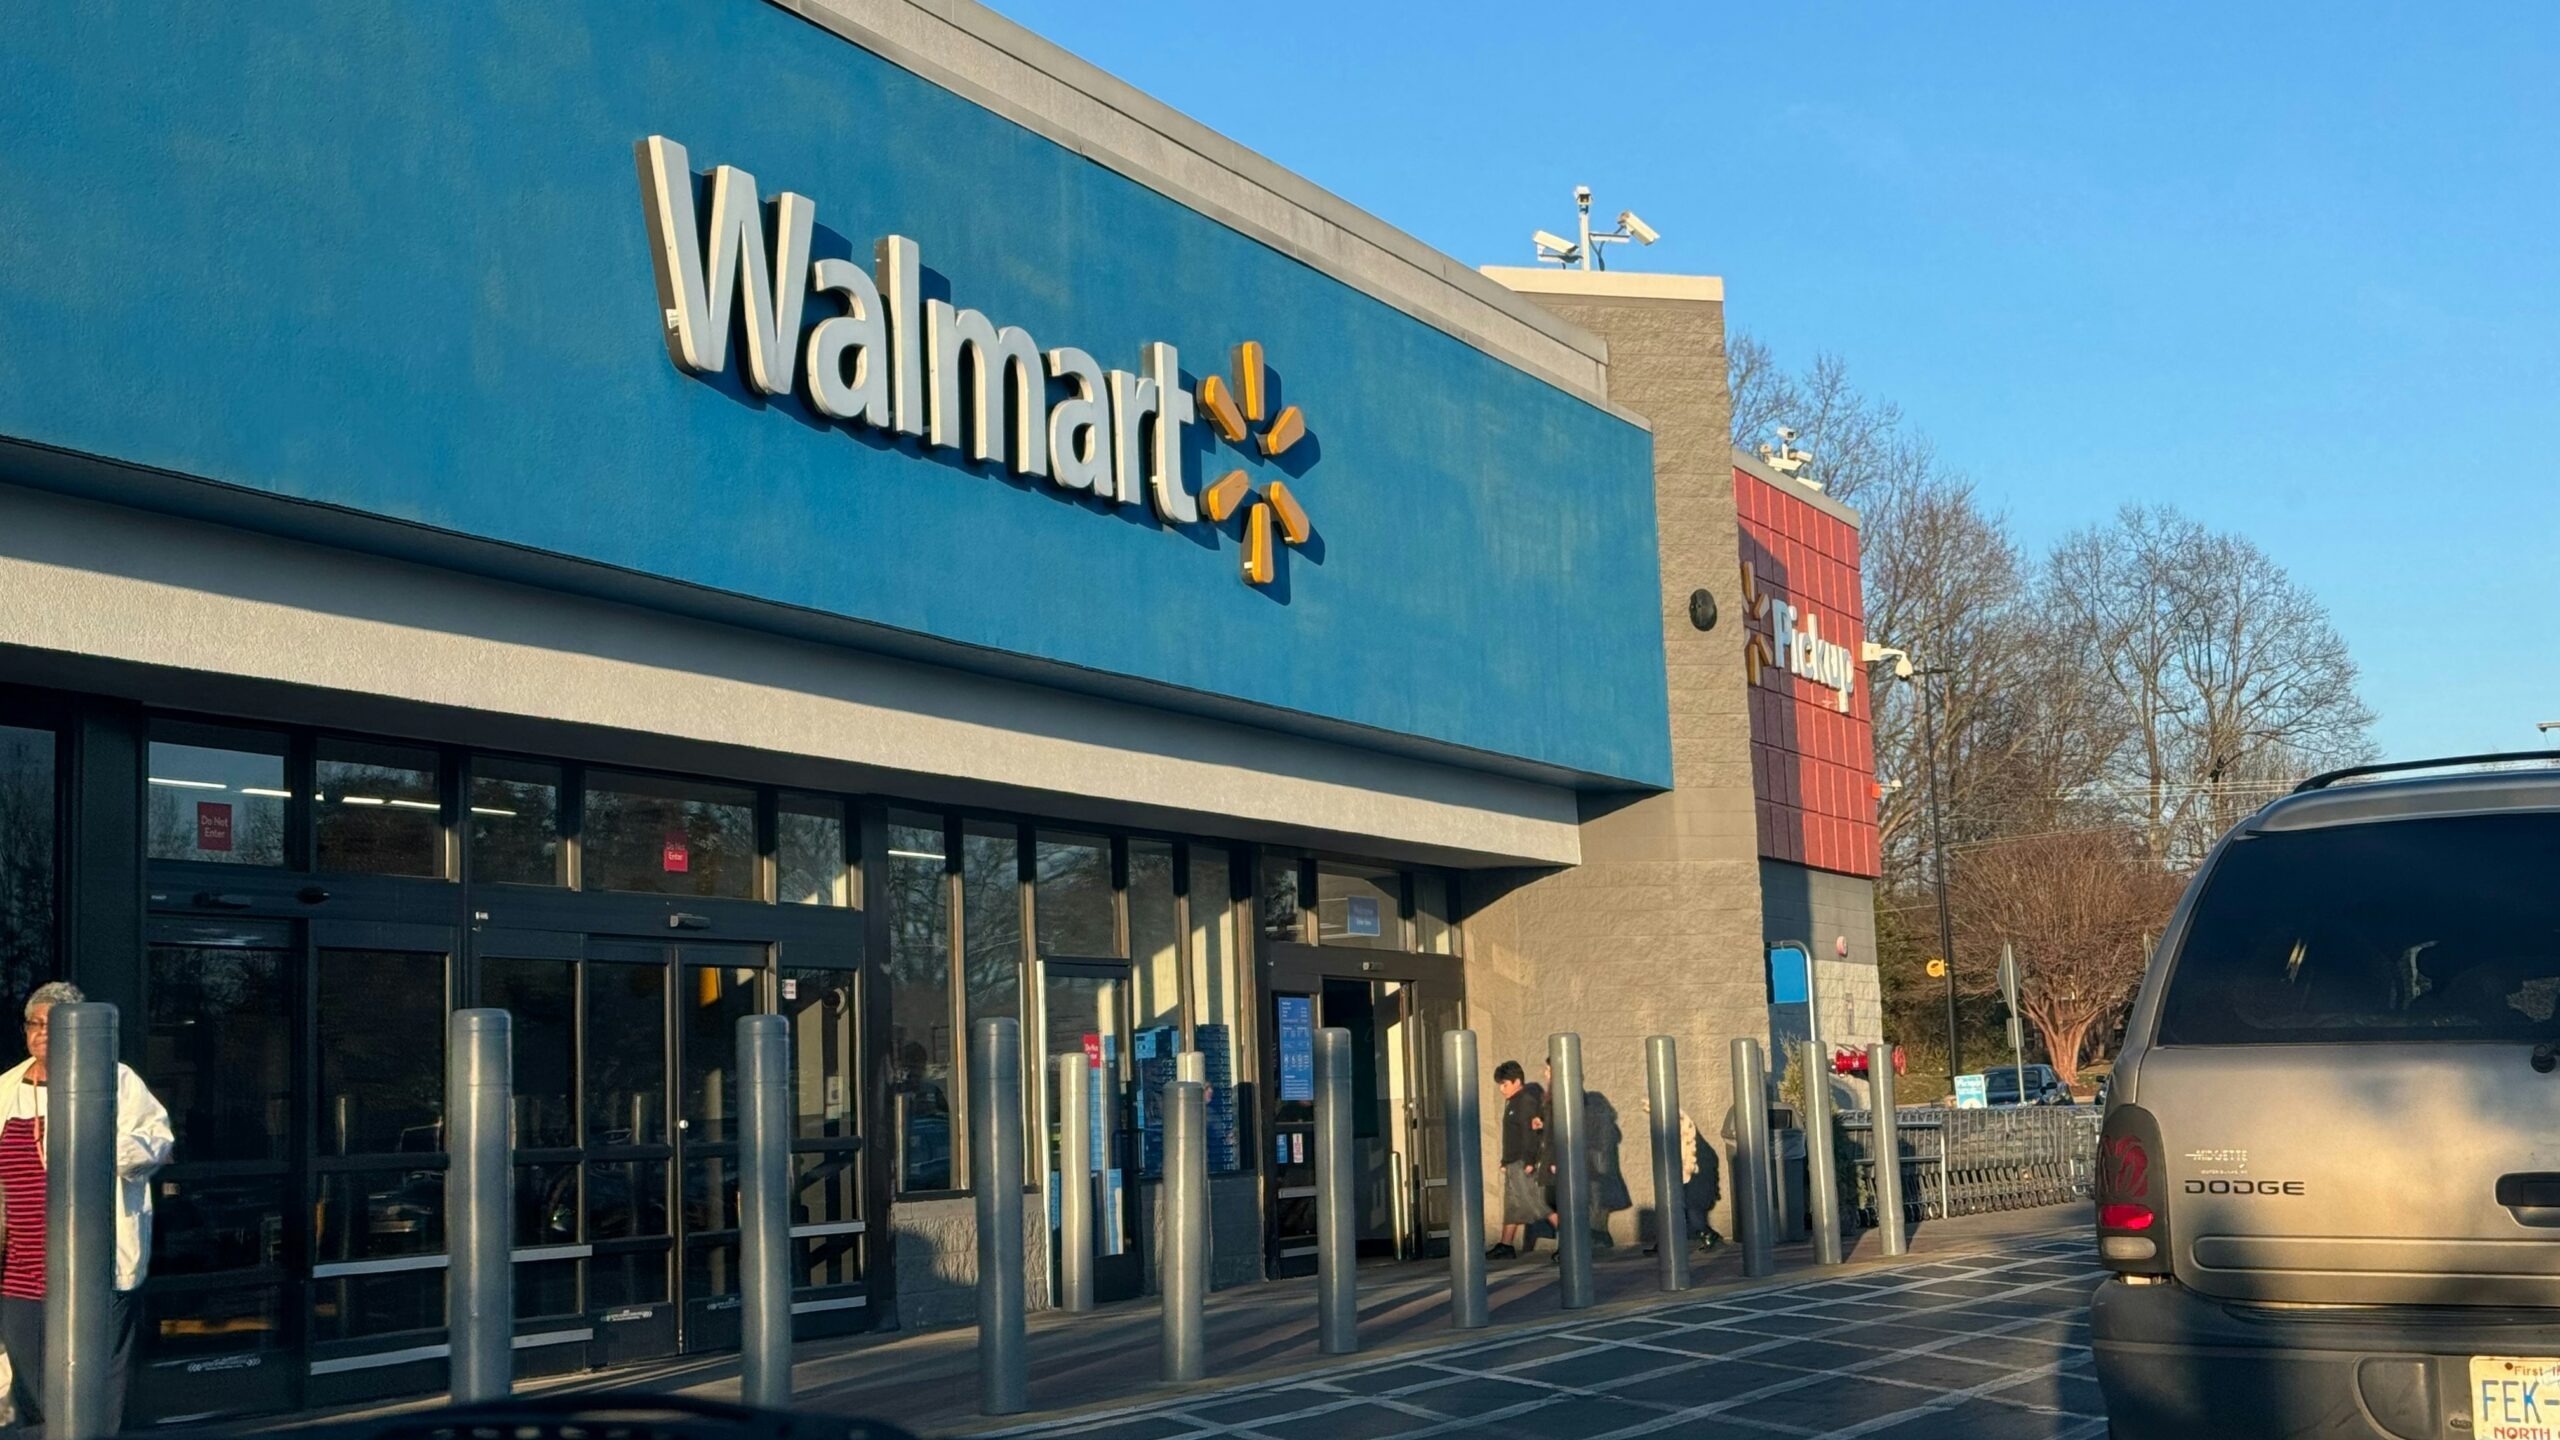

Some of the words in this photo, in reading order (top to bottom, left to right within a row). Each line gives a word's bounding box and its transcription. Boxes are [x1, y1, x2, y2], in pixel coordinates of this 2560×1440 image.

[637, 135, 1198, 524] Walmart
[1772, 599, 1854, 713] Pickup
[201, 815, 212, 826] Do
[214, 816, 228, 827] Not
[204, 827, 225, 838] Enter
[2185, 1180, 2304, 1195] DODGE
[2514, 1366, 2543, 1376] First
[2494, 1426, 2550, 1440] NORTH
